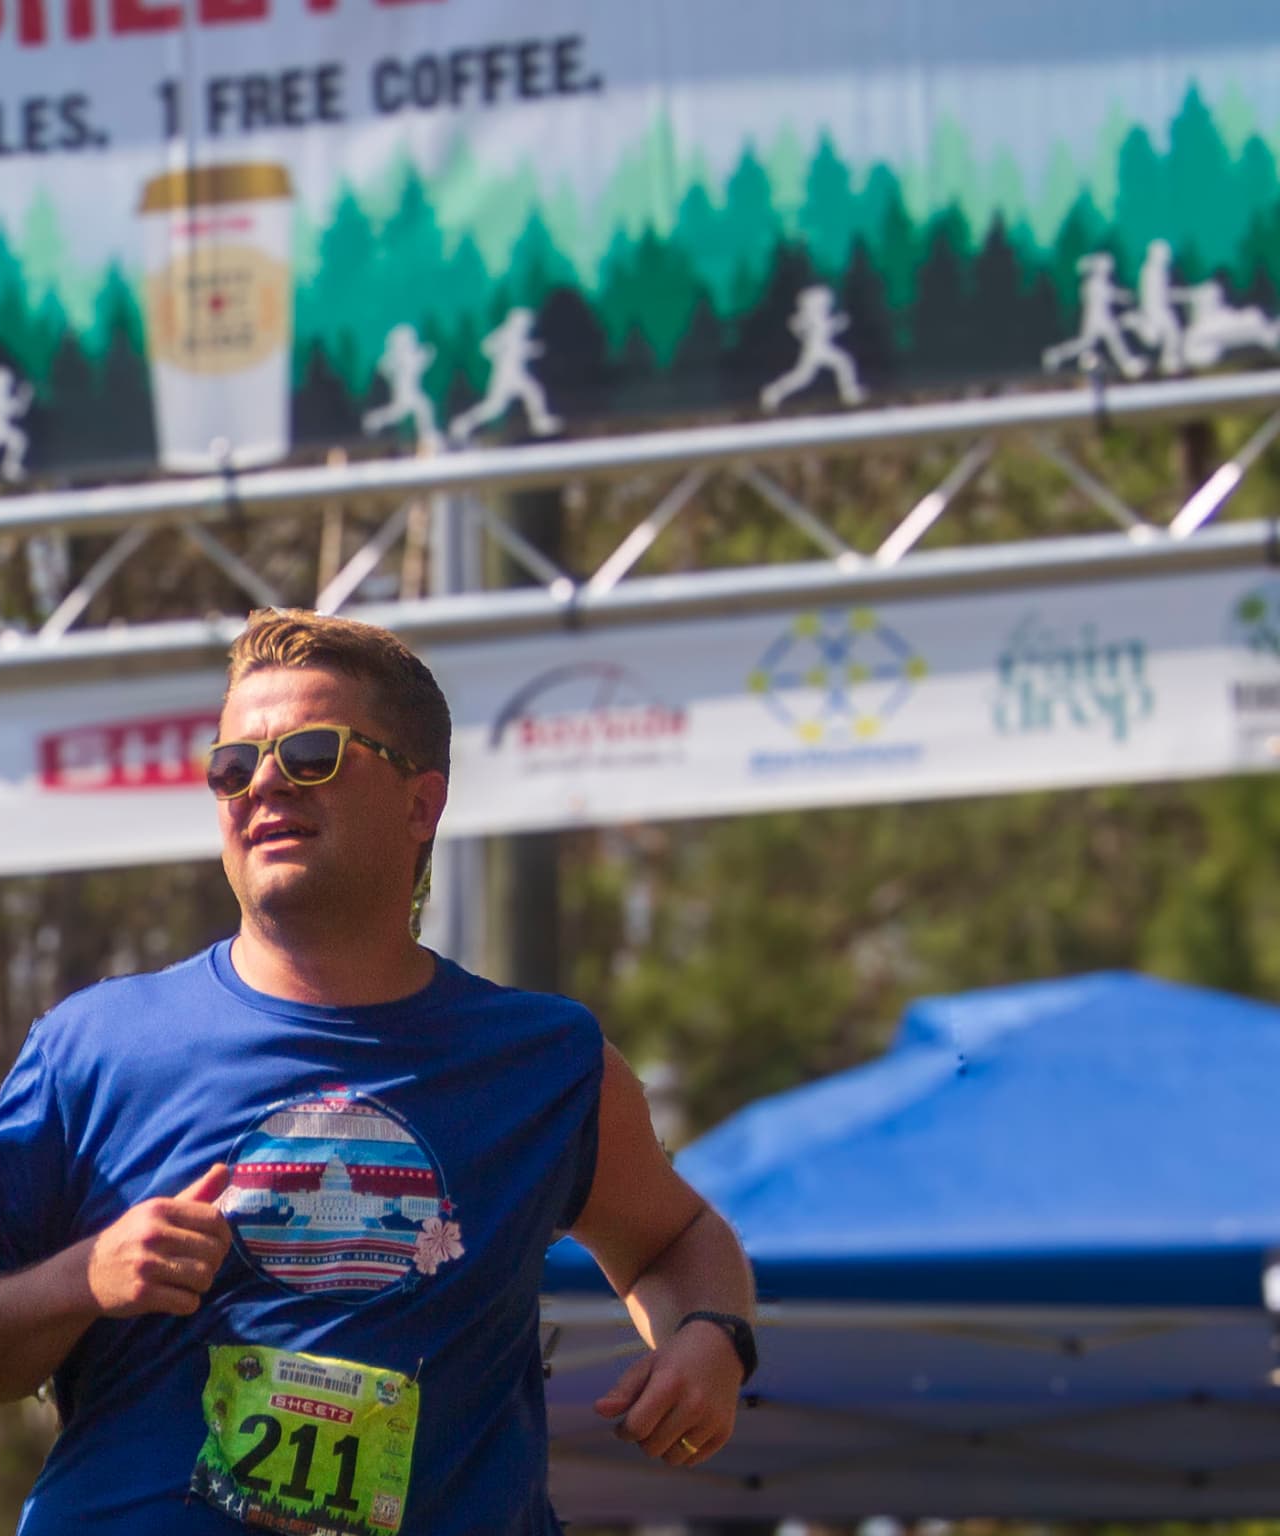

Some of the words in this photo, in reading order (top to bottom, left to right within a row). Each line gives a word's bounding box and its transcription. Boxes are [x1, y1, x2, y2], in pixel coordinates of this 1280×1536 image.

[156, 80, 184, 138] 1
[206, 66, 346, 136] FREE
[372, 36, 603, 116] COFFEE.
[275, 1396, 350, 1421] SHEETZ
[230, 1414, 359, 1512] 211
